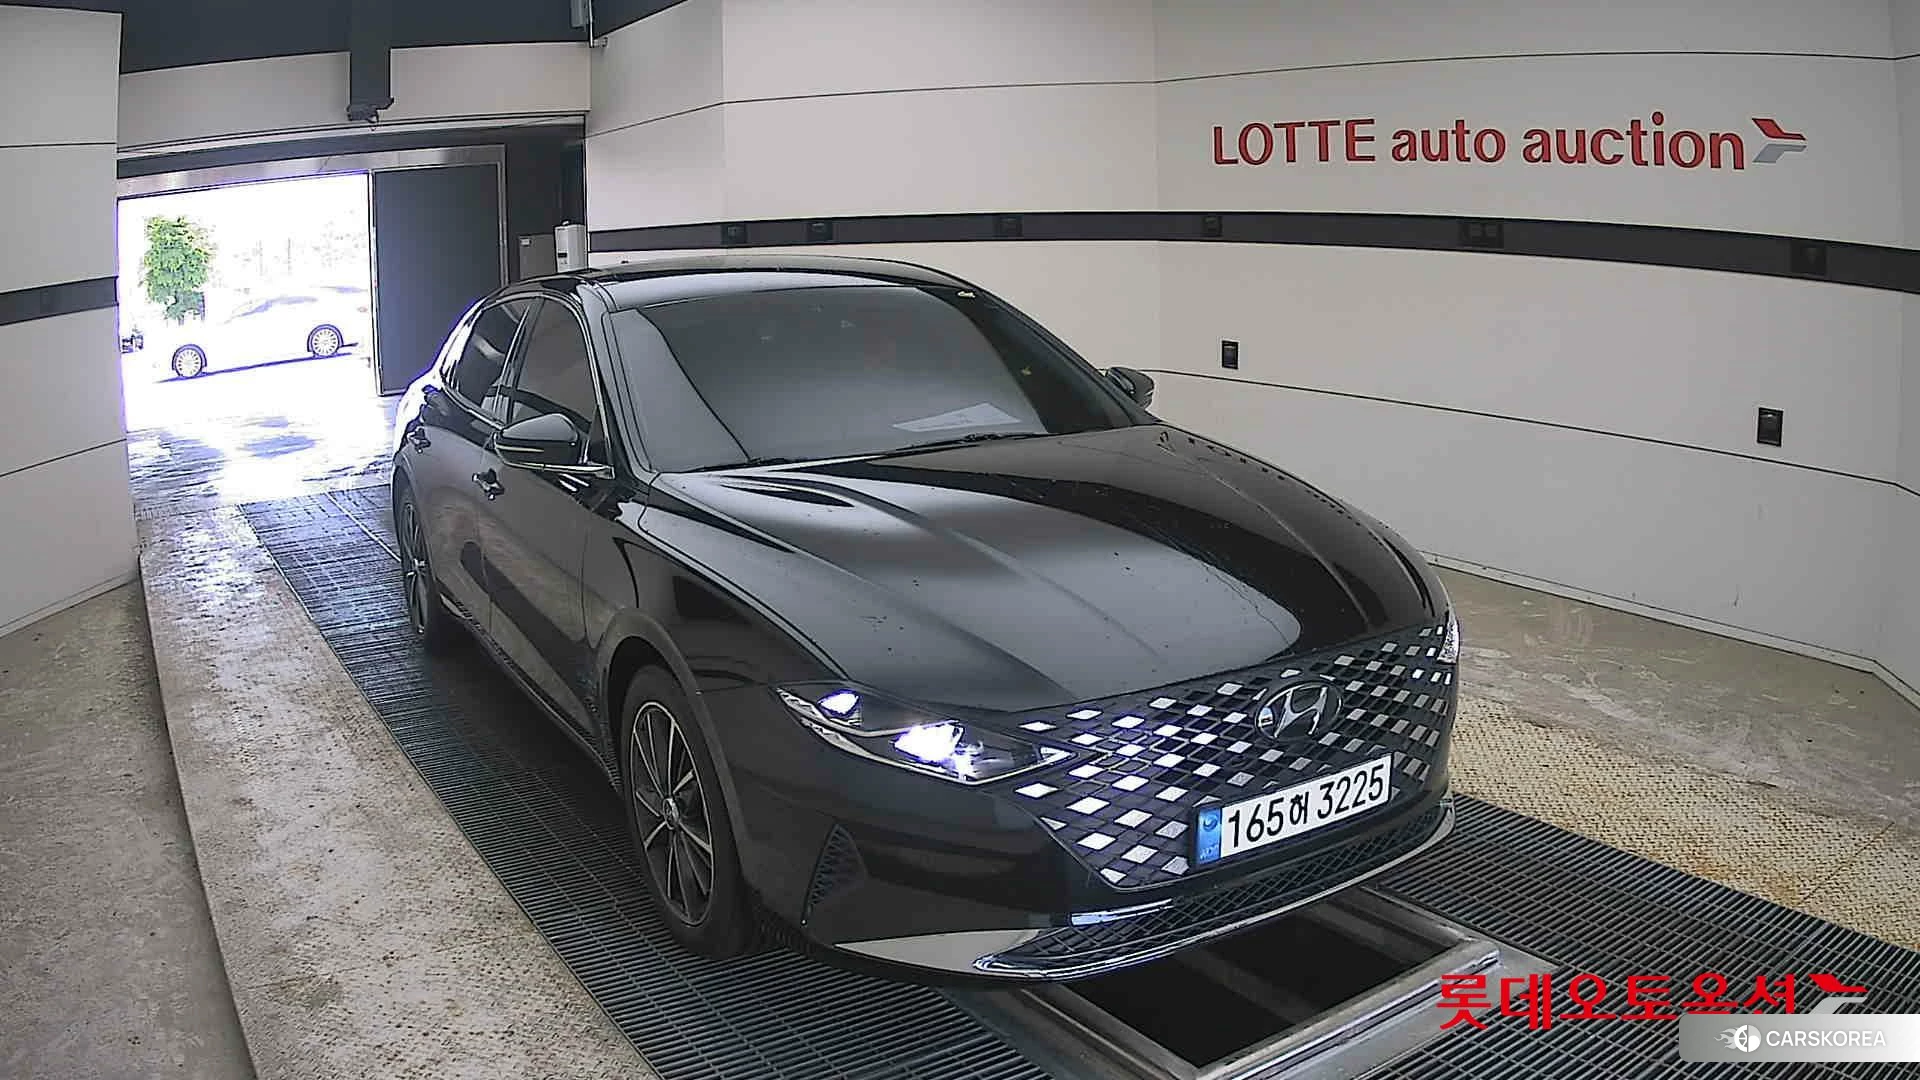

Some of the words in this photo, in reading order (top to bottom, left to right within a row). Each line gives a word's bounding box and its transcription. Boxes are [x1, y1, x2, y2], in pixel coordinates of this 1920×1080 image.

[1213, 119, 1376, 165] LOTTE
[1392, 119, 1506, 163] auto
[1523, 111, 1745, 170] auction
[1228, 791, 1310, 848] 165허
[1318, 764, 1385, 820] 3225
